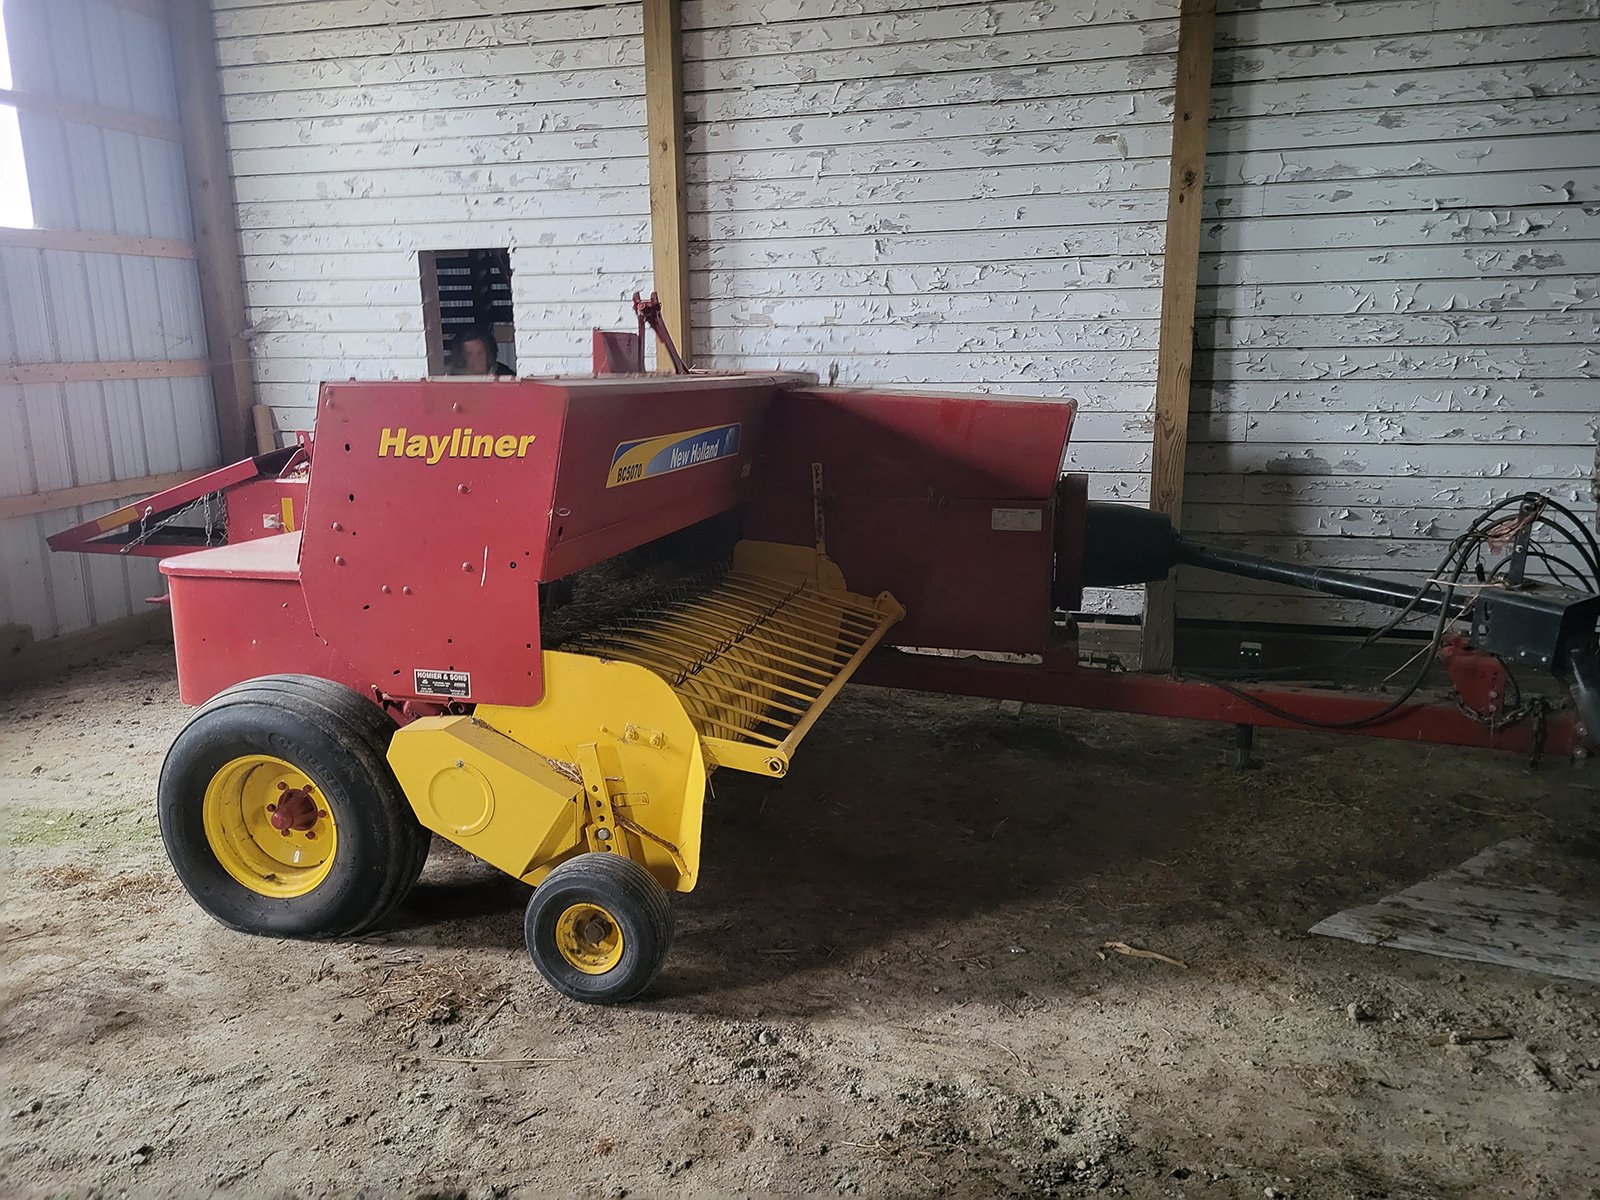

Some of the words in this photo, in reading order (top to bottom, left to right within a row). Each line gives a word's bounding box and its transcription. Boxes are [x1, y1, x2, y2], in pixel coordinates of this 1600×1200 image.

[378, 428, 536, 465] Hayliner
[669, 447, 691, 469] New
[690, 438, 720, 464] Holland
[616, 463, 643, 483] BC5070
[450, 674, 468, 682] SONS
